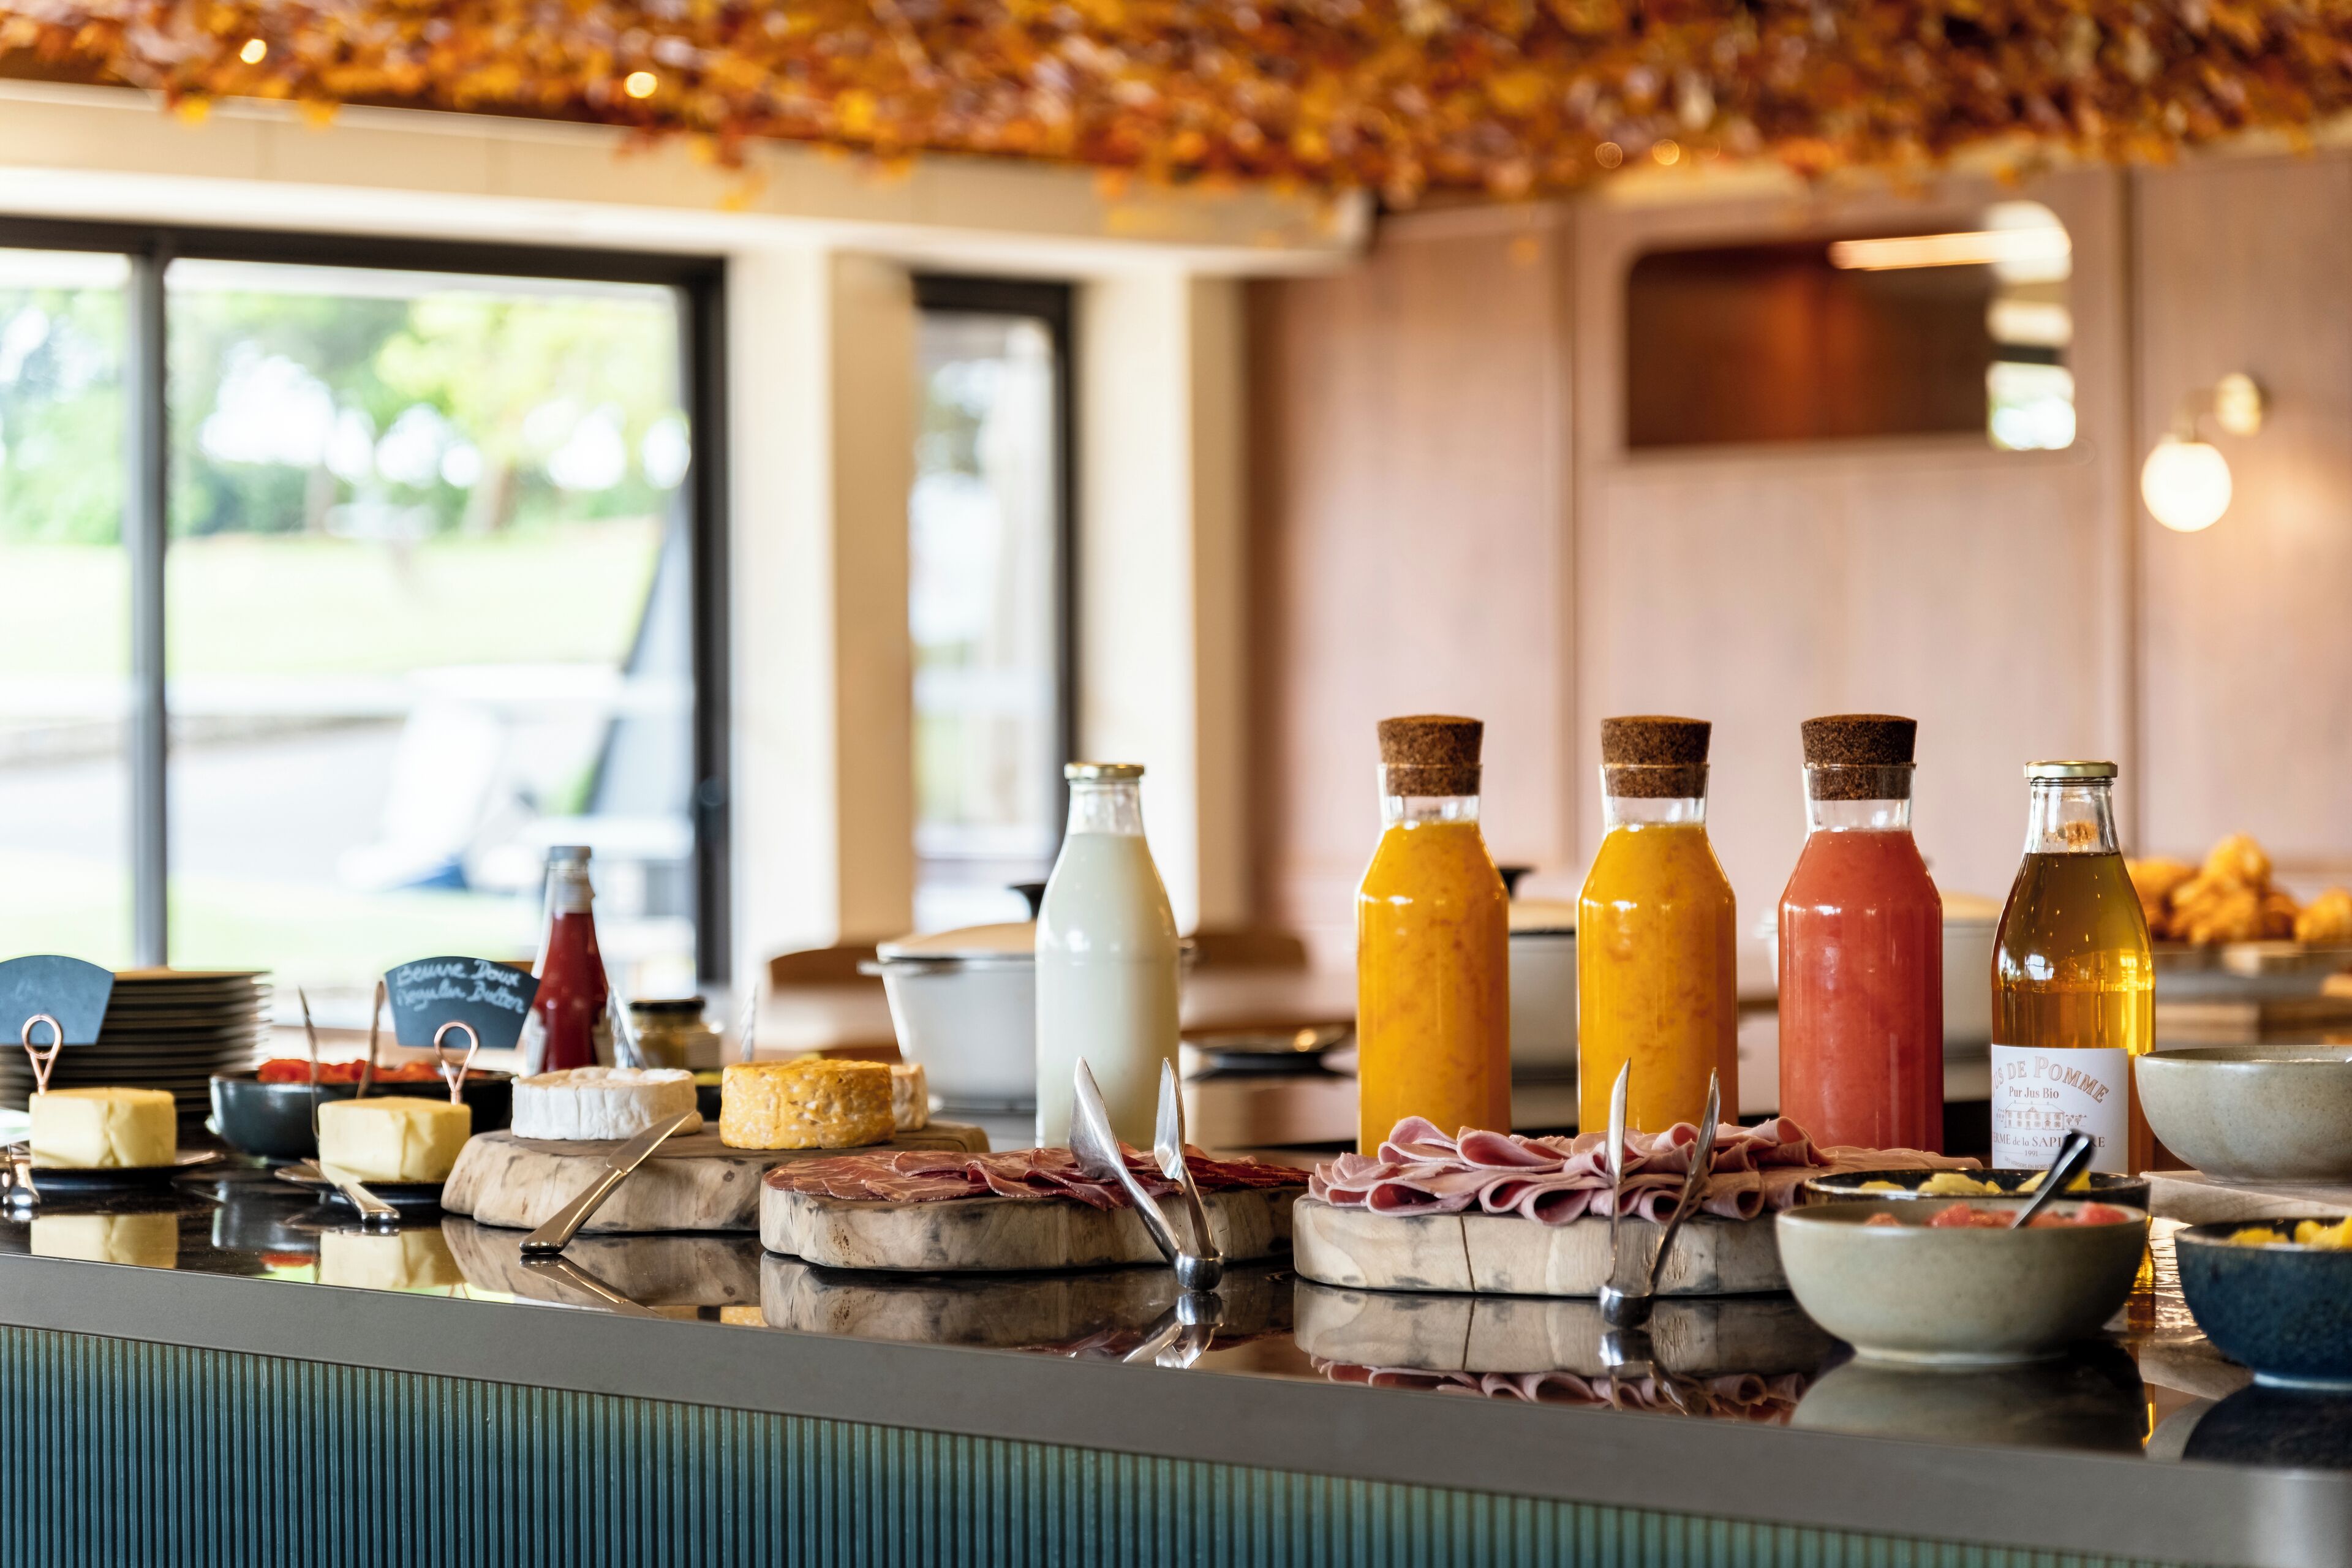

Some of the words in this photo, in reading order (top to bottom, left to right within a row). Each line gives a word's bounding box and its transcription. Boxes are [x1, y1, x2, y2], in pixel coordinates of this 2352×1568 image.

[470, 959, 520, 987] Doux
[2007, 1060, 2027, 1080] DE
[2033, 1055, 2109, 1104] POMME
[2009, 1086, 2022, 1098] Pur
[2024, 1087, 2040, 1098] Jus
[2043, 1088, 2059, 1099] Bio
[1993, 1132, 2011, 1145] ERME
[2013, 1136, 2021, 1146] de
[2022, 1137, 2029, 1146] la
